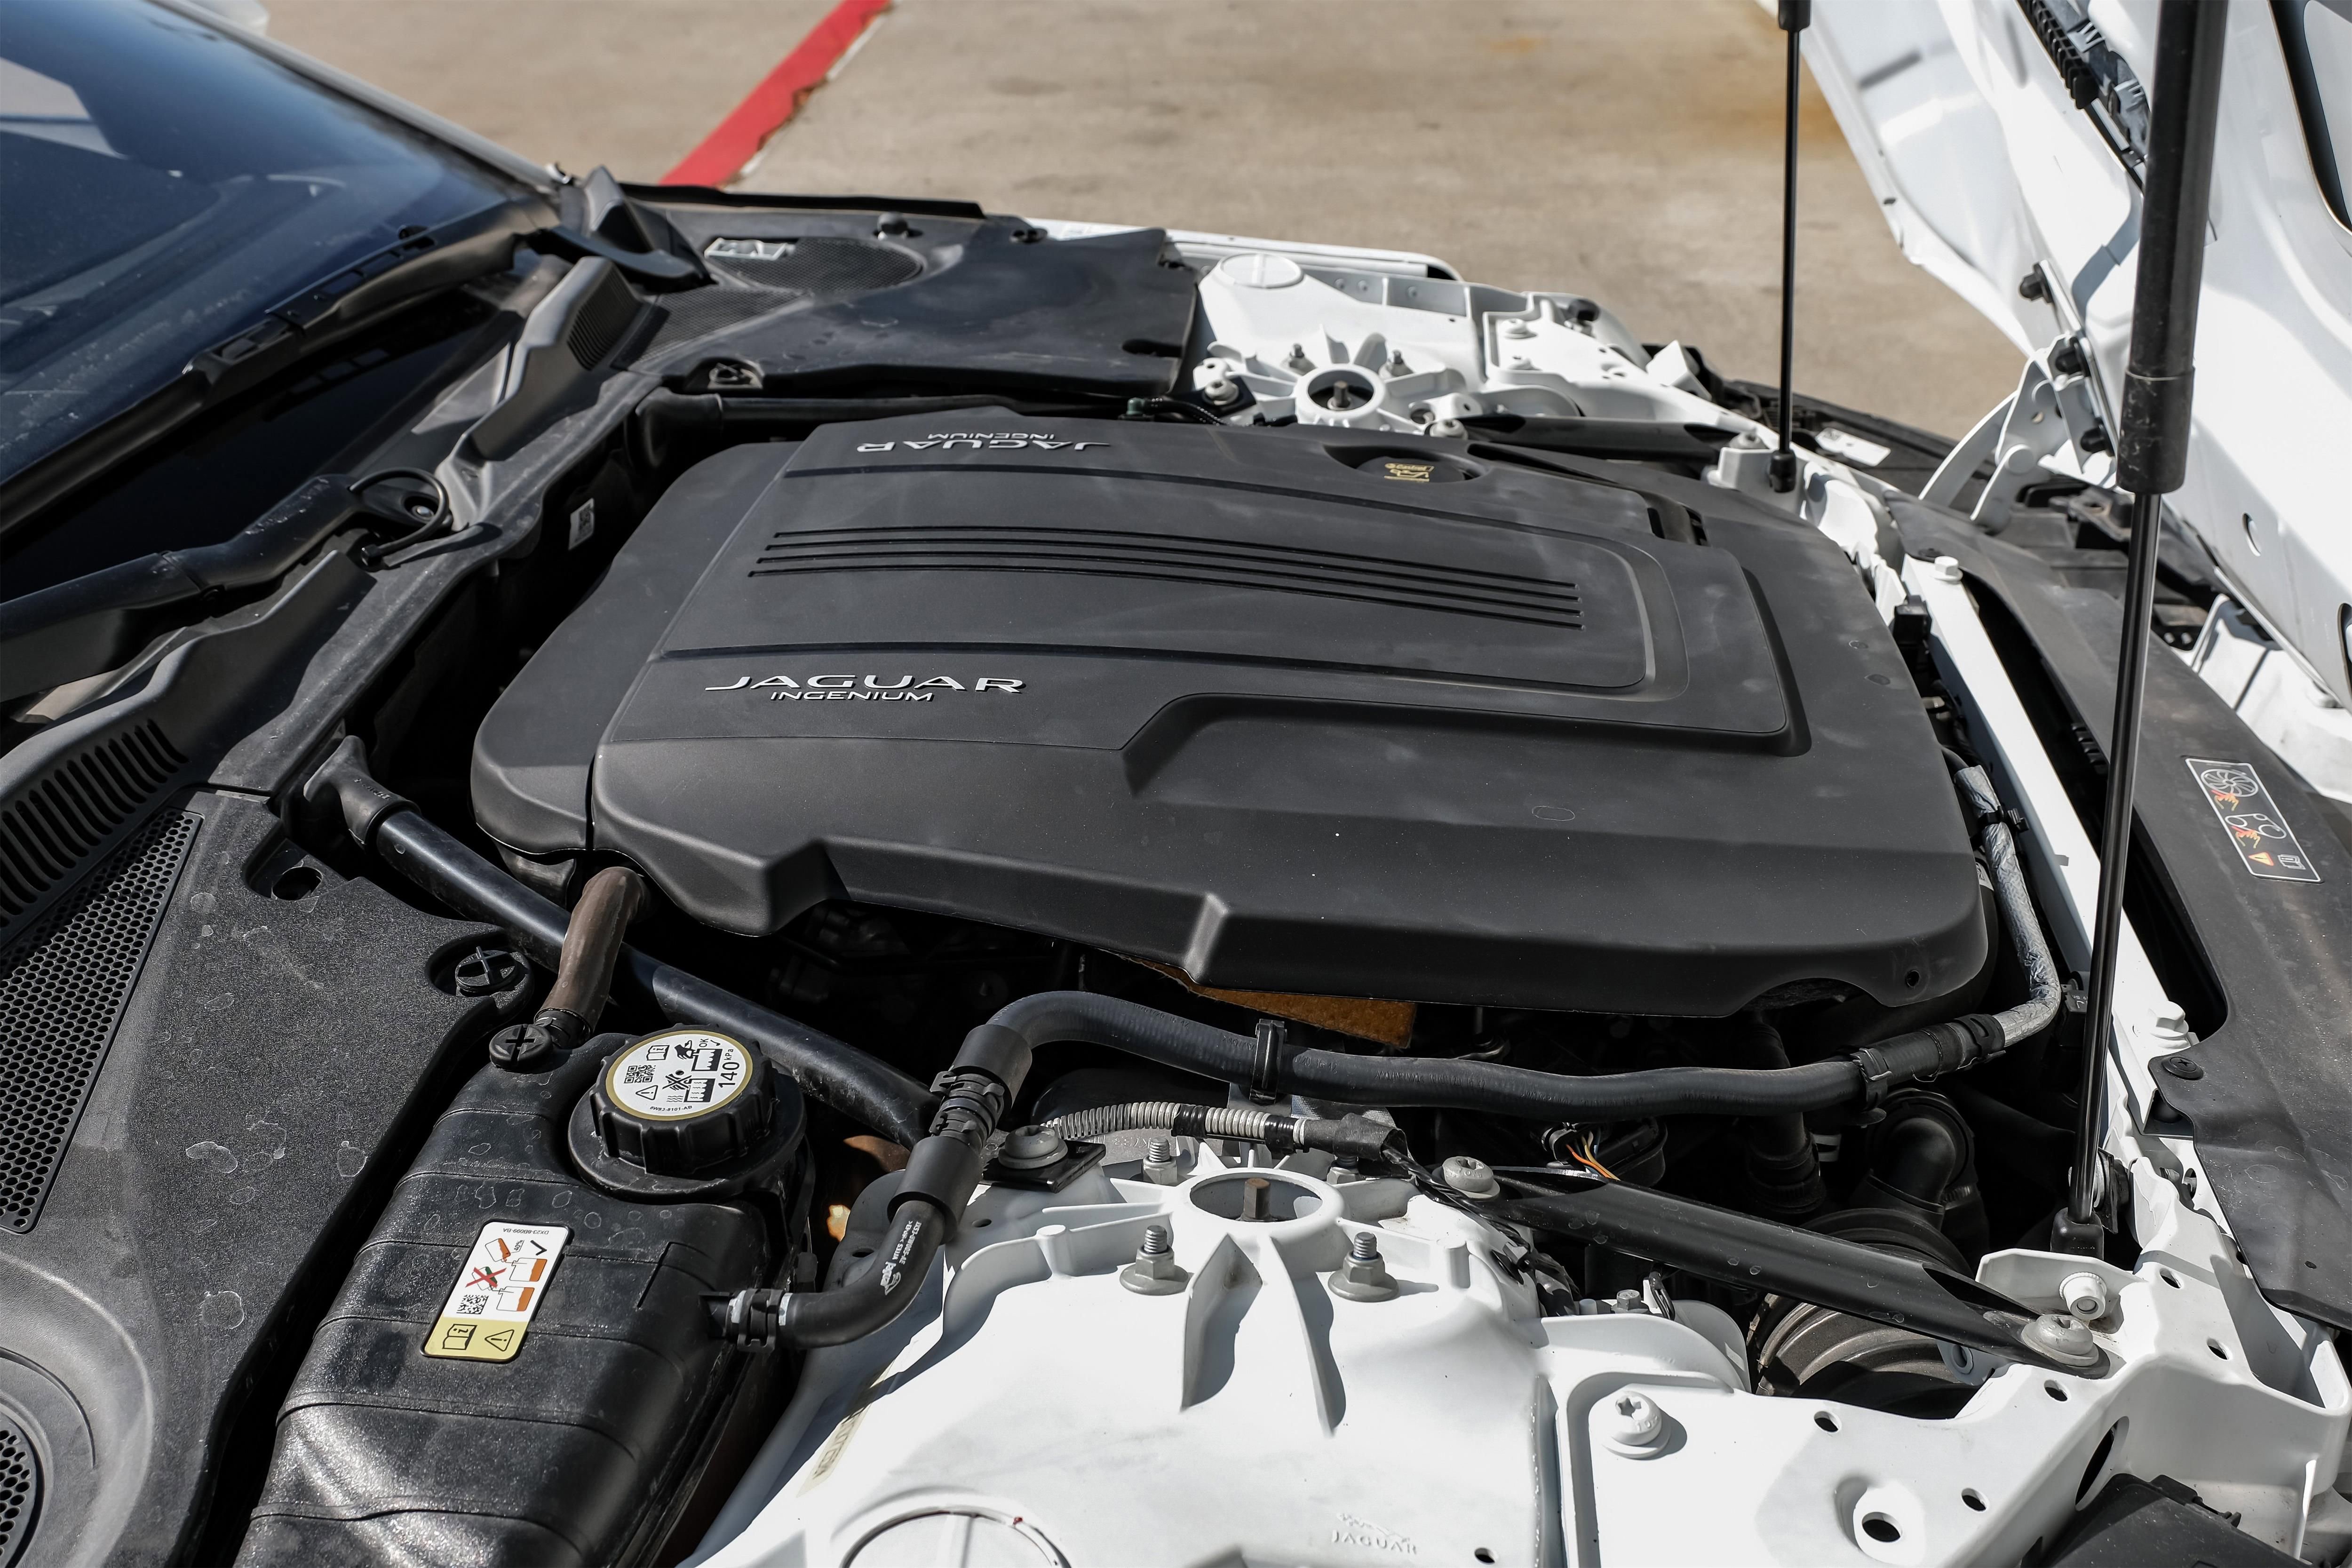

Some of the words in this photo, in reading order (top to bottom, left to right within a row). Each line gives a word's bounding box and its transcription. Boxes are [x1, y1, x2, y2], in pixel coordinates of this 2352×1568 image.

[857, 439, 1111, 452] JAGUAR
[705, 675, 1025, 693] JAGUAR
[771, 691, 934, 701] INGENIUM
[698, 1038, 709, 1048] OK
[723, 1049, 734, 1061] kPa
[718, 1061, 740, 1088] 140
